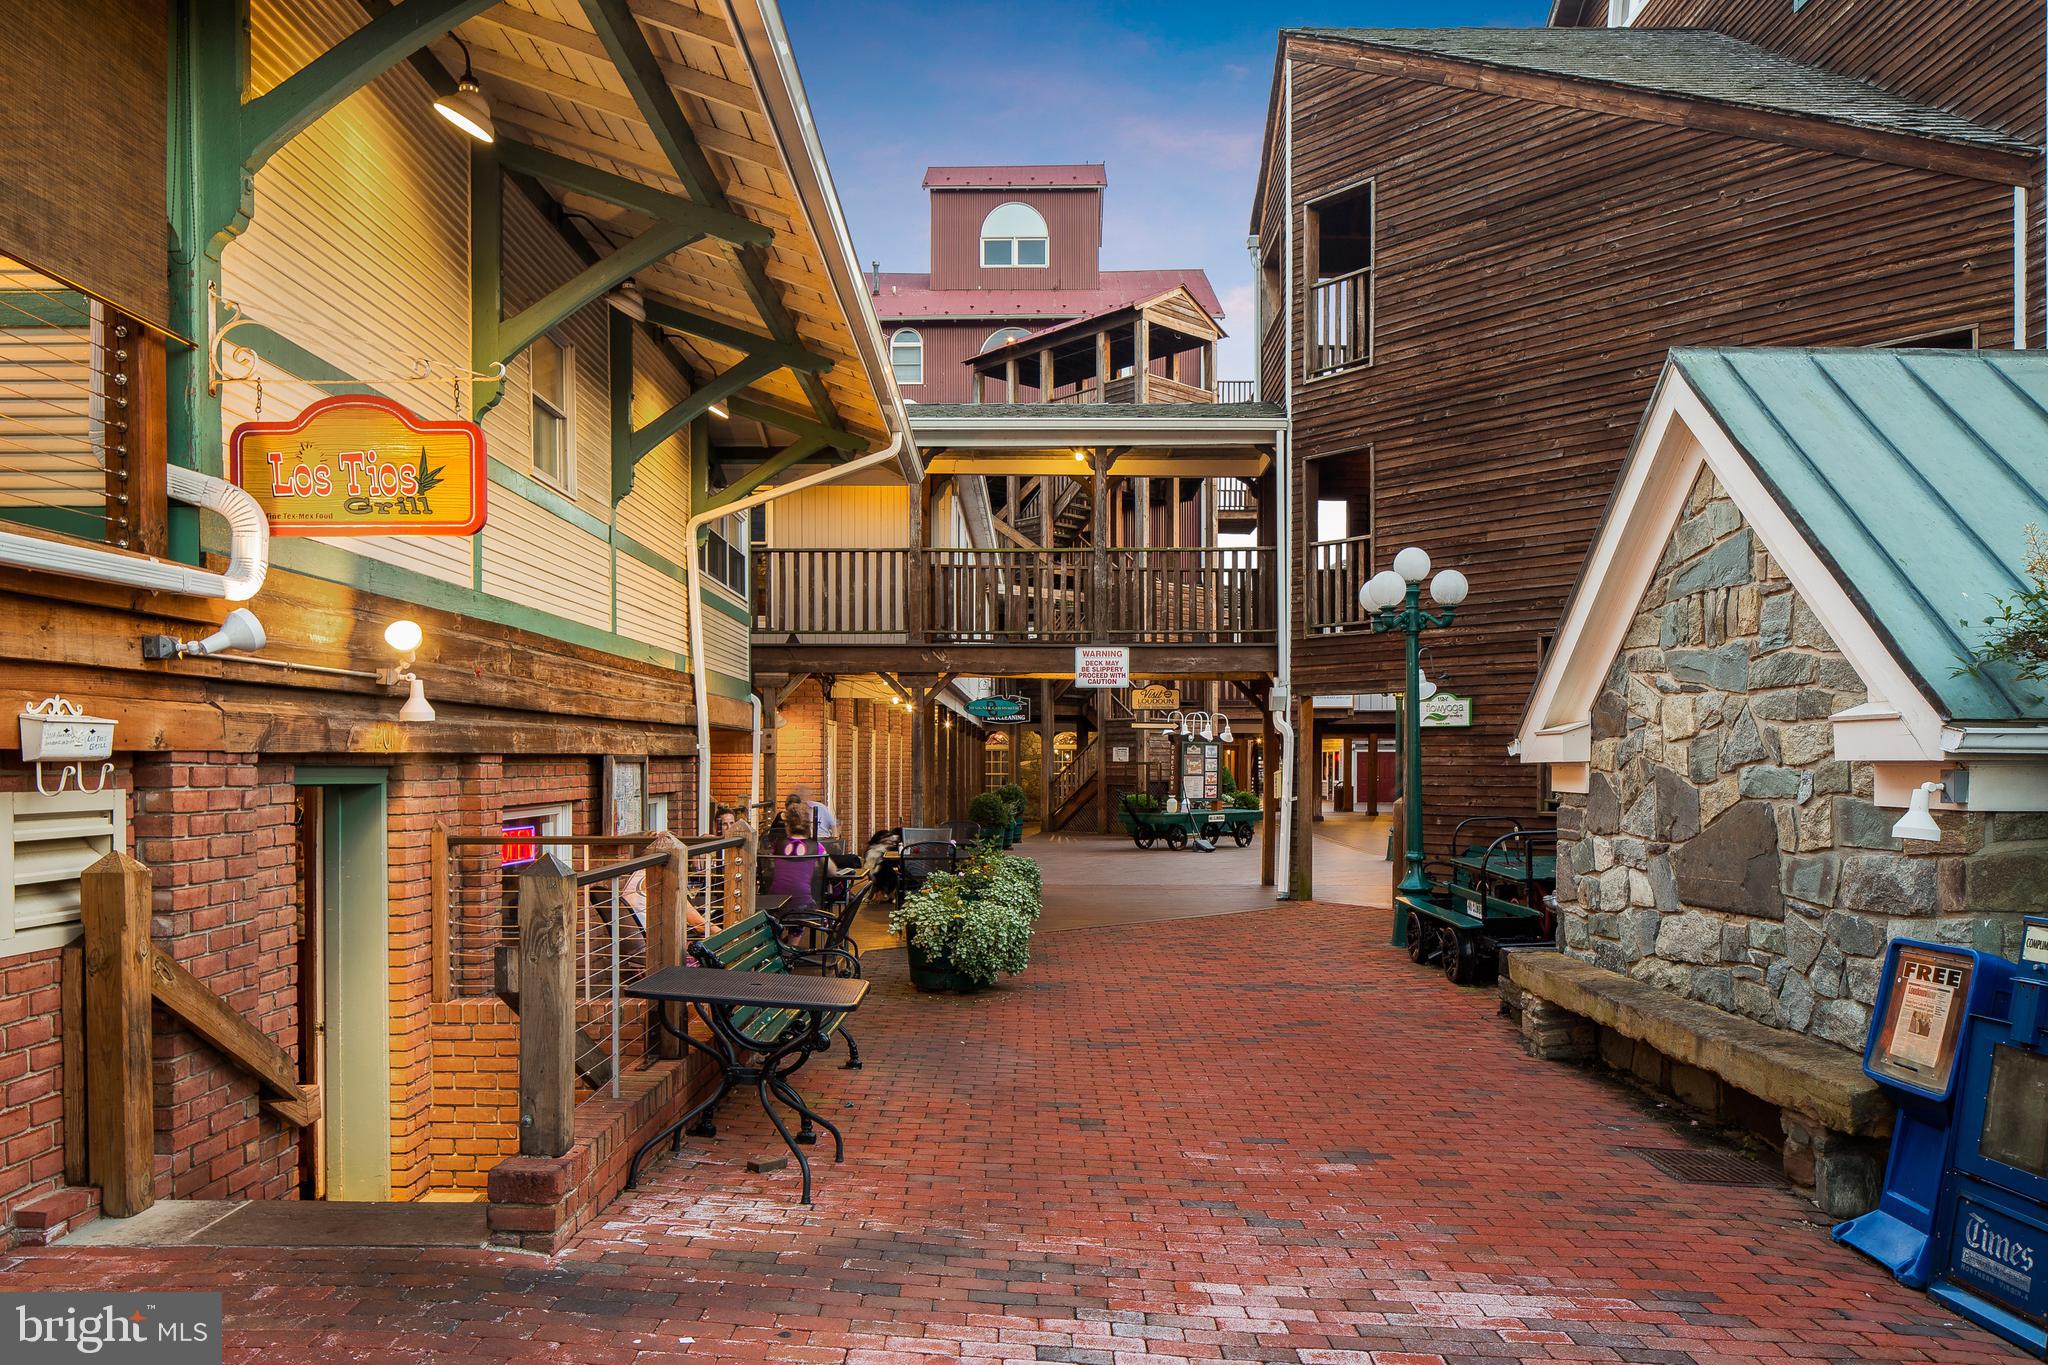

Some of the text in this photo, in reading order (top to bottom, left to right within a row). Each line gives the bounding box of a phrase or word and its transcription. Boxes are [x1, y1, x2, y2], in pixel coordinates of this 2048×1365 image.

[267, 450, 419, 497] Los Tios
[283, 512, 314, 520] Tex-Mex
[315, 512, 334, 520] Food
[343, 497, 434, 515] Grill
[1082, 650, 1123, 658] WARNING
[1140, 689, 1164, 699] Visit
[1903, 962, 1961, 988] FREE
[1966, 1212, 2034, 1272] Times
[1998, 1279, 2030, 1301] VIRGINA
